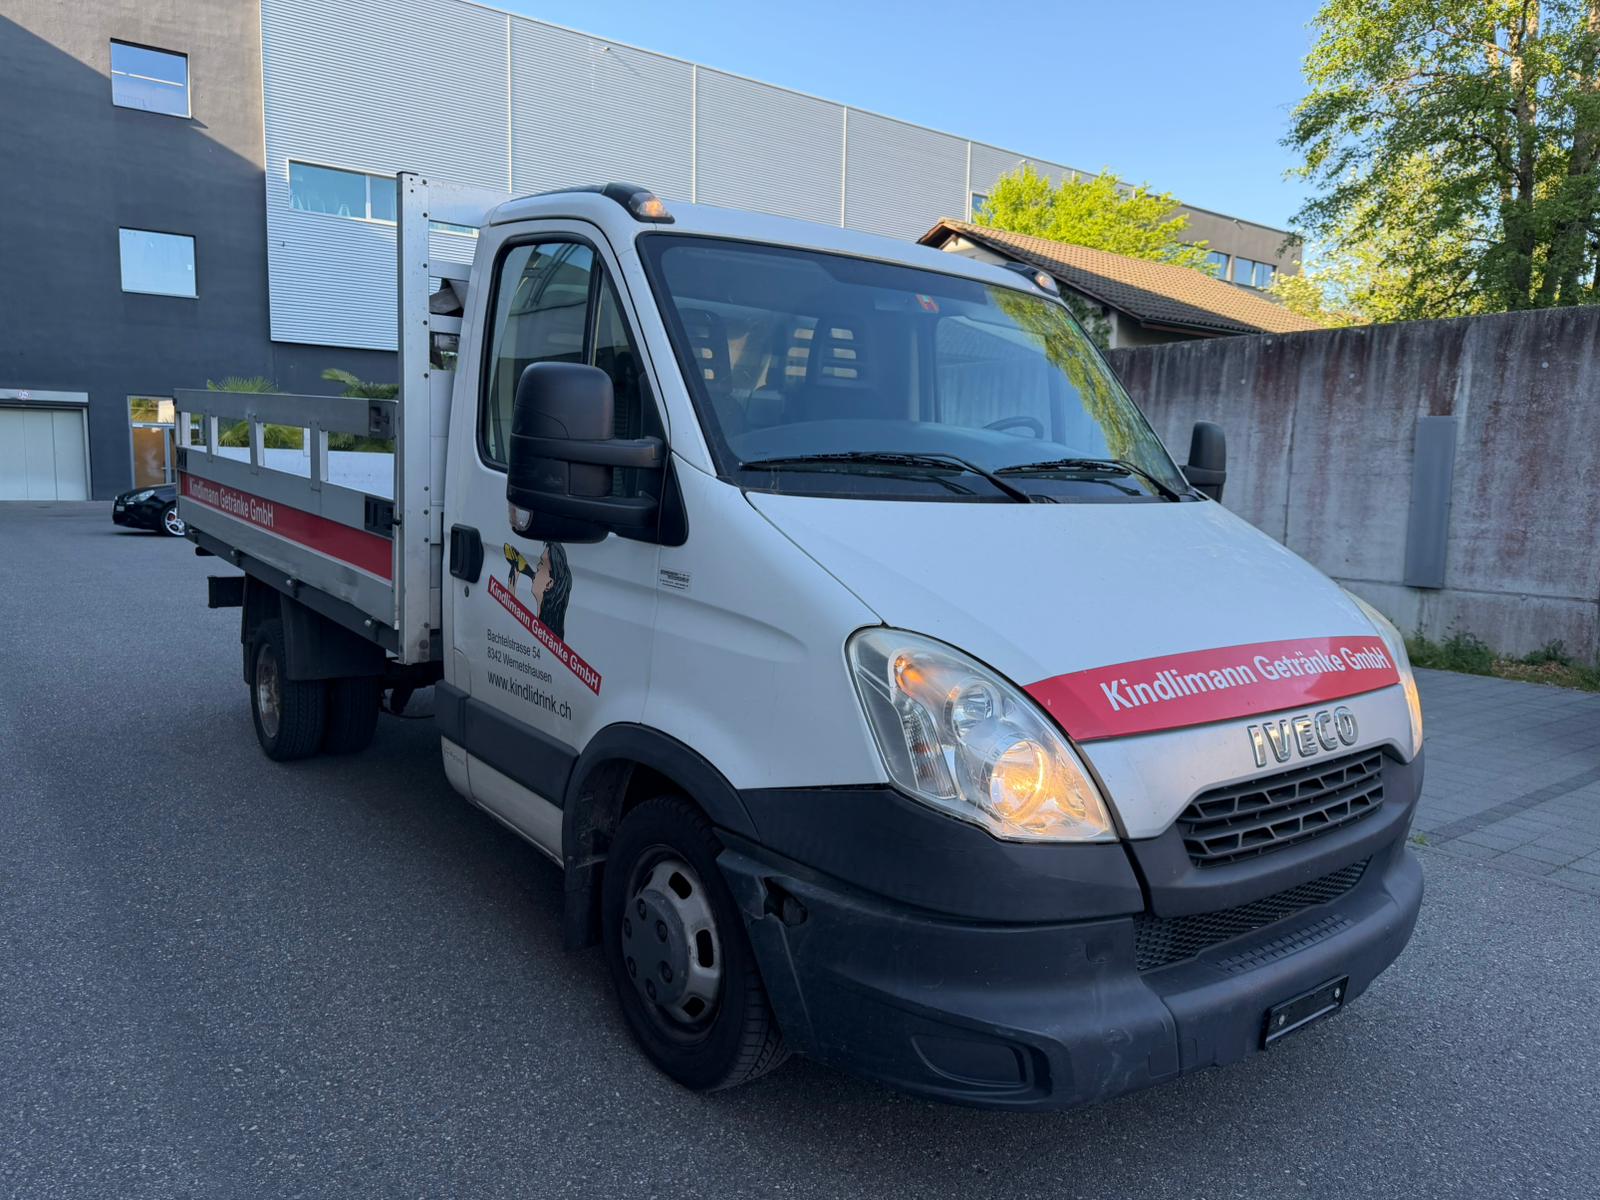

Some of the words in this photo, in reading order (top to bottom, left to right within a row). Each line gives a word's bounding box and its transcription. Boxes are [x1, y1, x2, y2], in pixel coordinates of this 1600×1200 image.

[219, 487, 249, 518] Getränke
[250, 499, 274, 528] GmbH
[487, 629, 531, 657] Bachtelstrasse
[532, 646, 541, 660] 54
[490, 580, 530, 628] Kindlimann
[531, 619, 568, 663] Getränke
[570, 655, 600, 690] GmbH
[487, 647, 502, 662] 8342
[502, 652, 553, 684] Wernetshausen
[1100, 664, 1255, 711] Kindlimann
[1254, 648, 1347, 681] Getränke
[1341, 646, 1391, 671] GmbH
[487, 671, 572, 720] www.kindlidrink.ch
[1247, 706, 1359, 768] IVECO
